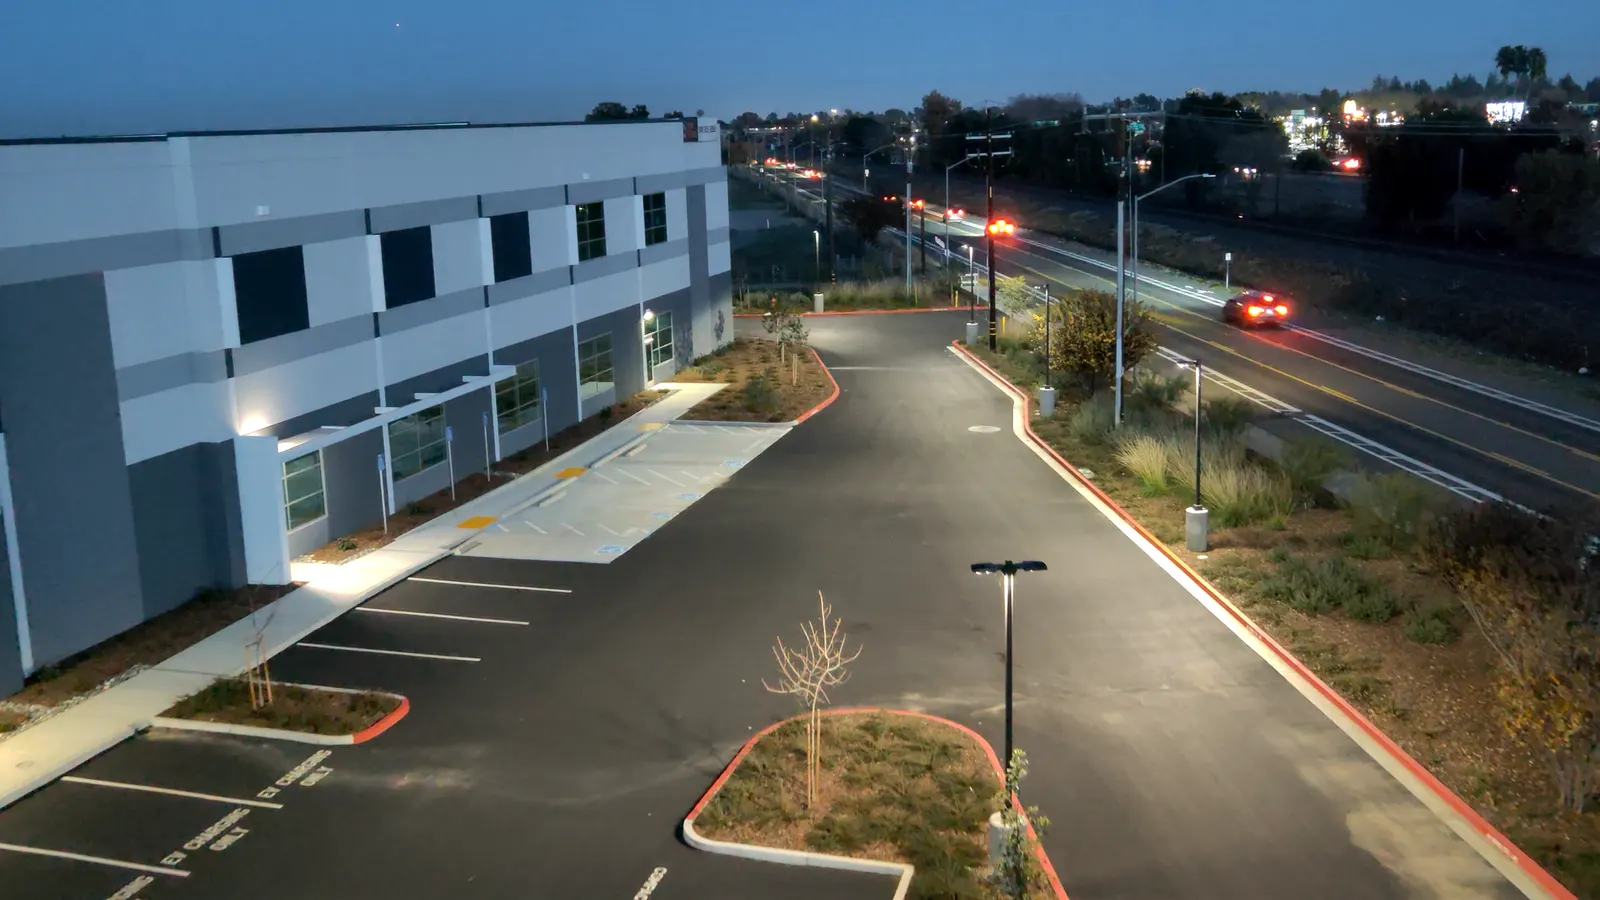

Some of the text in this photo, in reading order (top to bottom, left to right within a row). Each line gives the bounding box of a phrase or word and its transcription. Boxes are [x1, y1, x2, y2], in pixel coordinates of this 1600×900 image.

[299, 765, 334, 787] ONLY
[256, 786, 281, 799] EV
[209, 826, 250, 851] ONLY
[160, 850, 188, 866] EV
